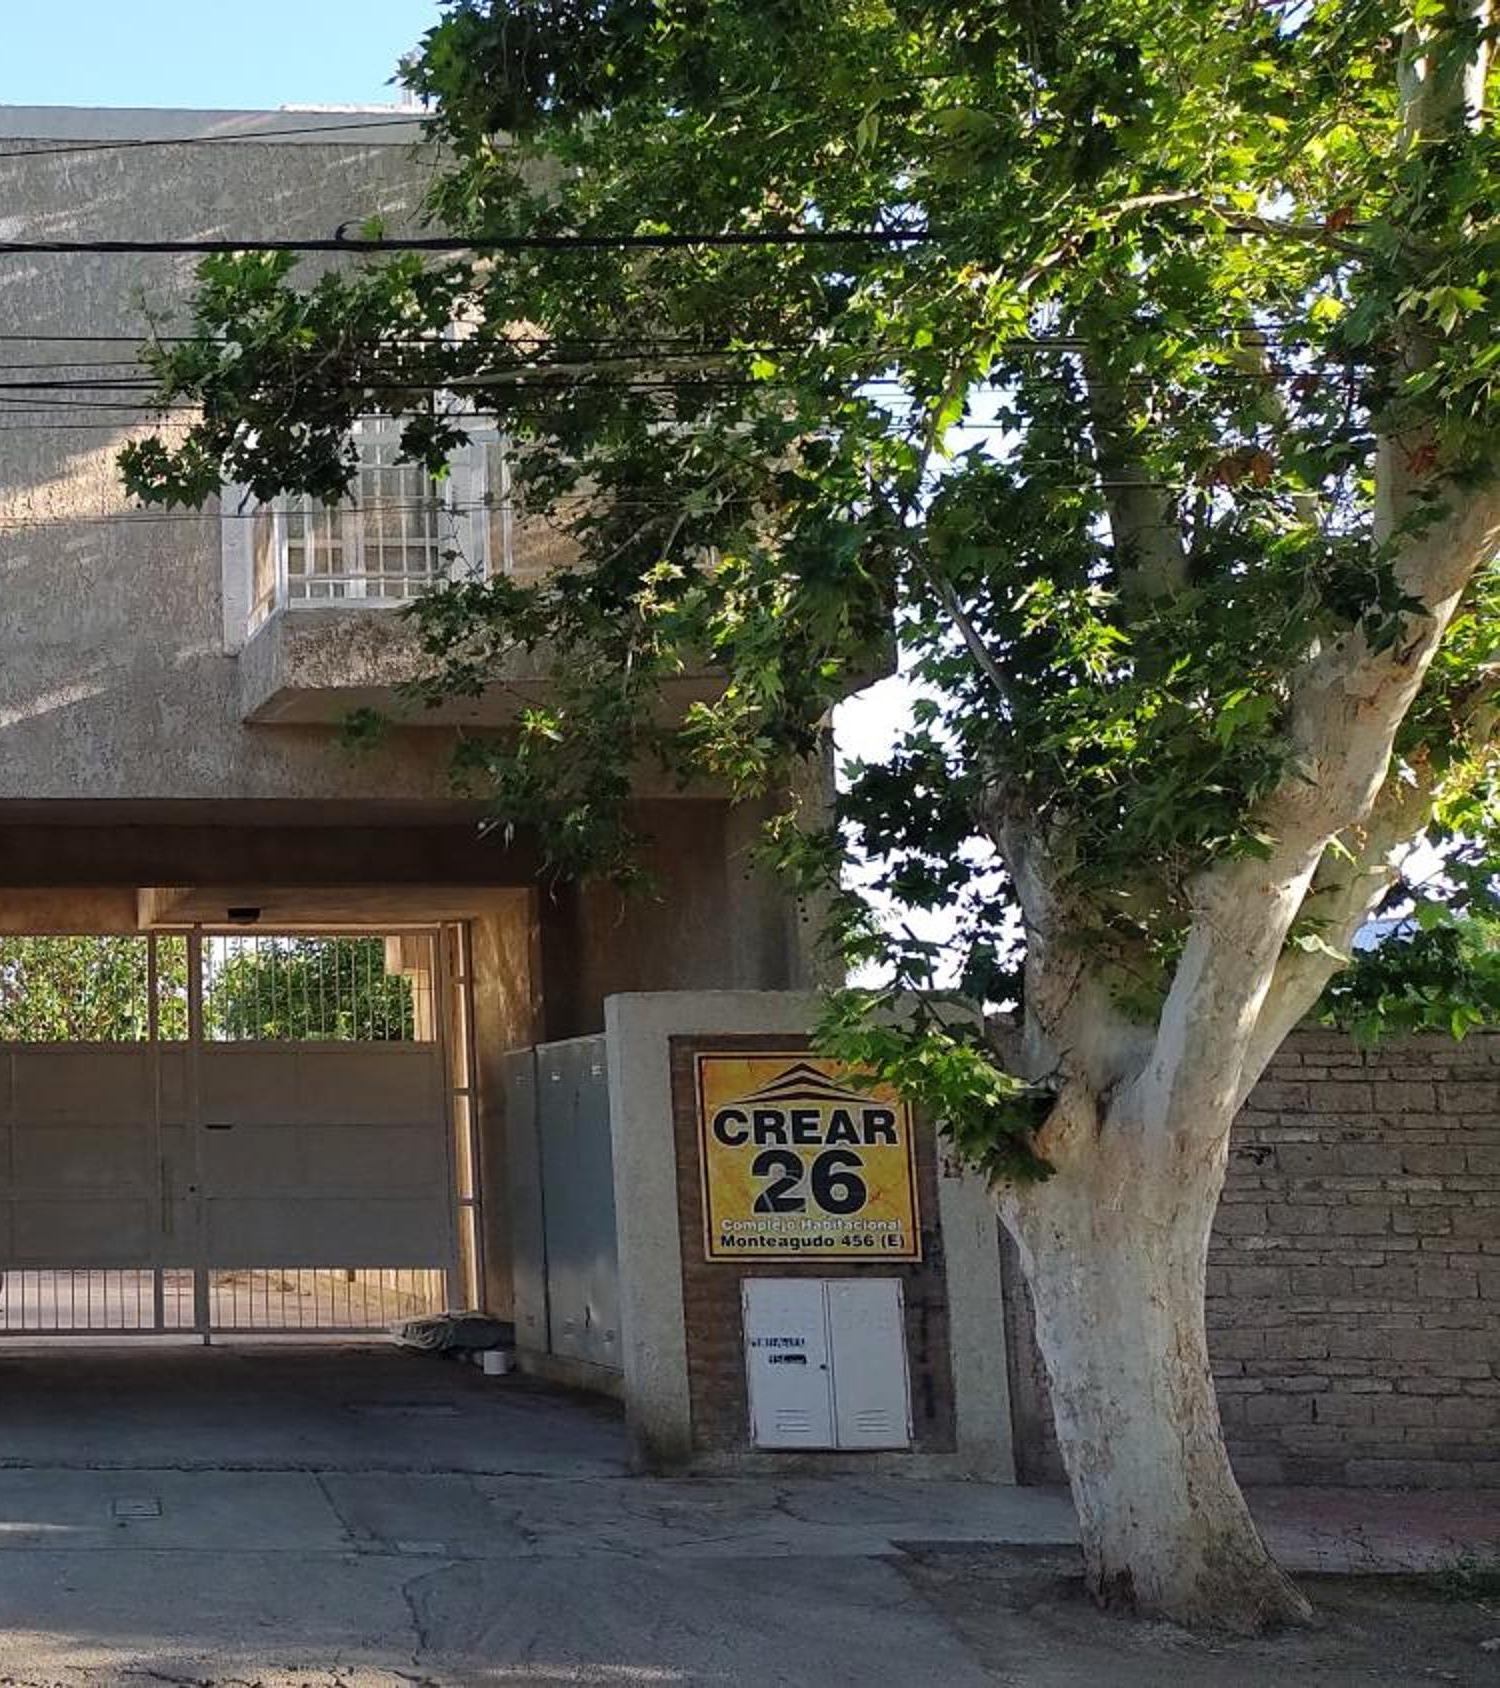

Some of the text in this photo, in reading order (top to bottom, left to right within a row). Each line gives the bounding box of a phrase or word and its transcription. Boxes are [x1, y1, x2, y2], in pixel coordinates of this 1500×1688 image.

[713, 1109, 898, 1146] CREAR
[752, 1149, 867, 1214] 26
[722, 1218, 902, 1233] Complejo Habitacional
[720, 1235, 905, 1250] Monteagudo 456 (E)
